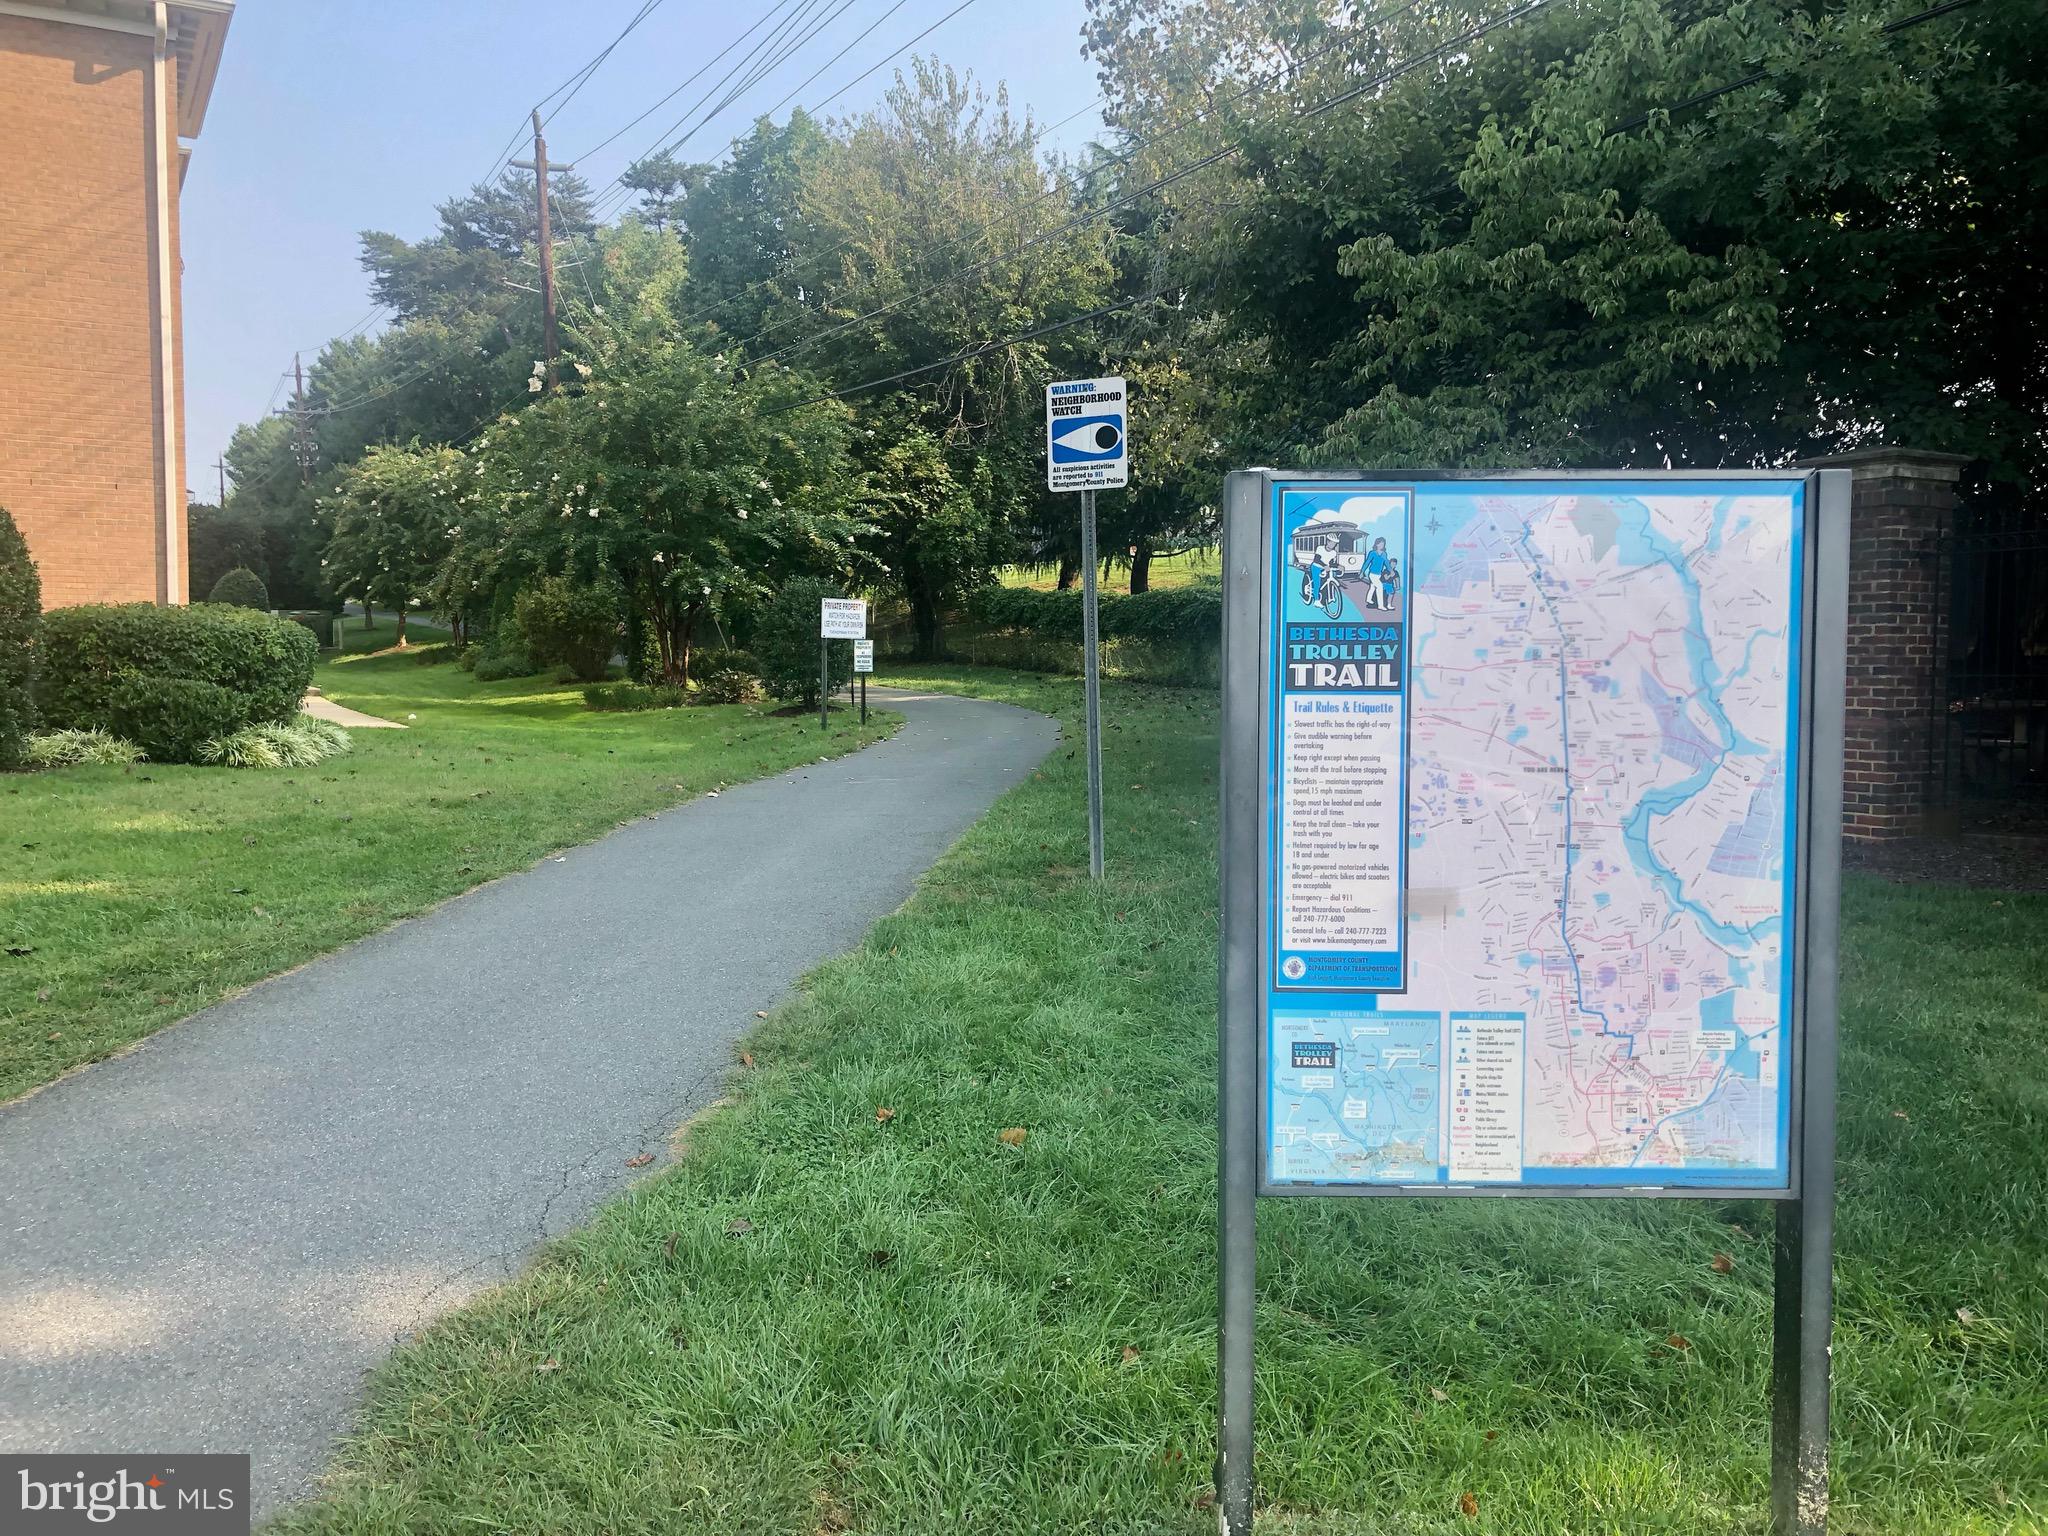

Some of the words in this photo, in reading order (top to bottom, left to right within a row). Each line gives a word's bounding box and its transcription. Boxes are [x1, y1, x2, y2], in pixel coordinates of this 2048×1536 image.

[1051, 383, 1096, 395] WARNING:
[1052, 392, 1122, 407] NEIGHBORHOOD
[1052, 406, 1082, 416] WATCH
[1062, 465, 1089, 473] suspicious
[1053, 480, 1086, 488] Montgomery
[1290, 628, 1398, 641] BETHESDA
[1290, 644, 1399, 660] TROLLEY
[1289, 664, 1399, 688] TRAIL
[1294, 701, 1313, 713] Trail
[1316, 701, 1340, 713] Rules
[1342, 701, 1350, 713] &
[1353, 701, 1394, 715] Etiquette
[1294, 720, 1315, 728] Slowest
[1316, 720, 1333, 728] traffic
[1335, 720, 1344, 728] has
[1346, 720, 1355, 728] the
[1330, 733, 1352, 741] warning
[1294, 742, 1324, 750] overtaking
[1294, 754, 1308, 762] Keep
[1309, 754, 1322, 762] right
[1324, 754, 1342, 762] except
[1360, 755, 1381, 763] passing
[1363, 767, 1387, 775] stopping
[1314, 842, 1338, 850] required
[1339, 842, 1346, 850] by
[1292, 872, 1313, 880] allowed
[1320, 872, 1338, 880] electric
[1340, 872, 1355, 880] bikes
[1356, 872, 1366, 880] and
[1368, 872, 1390, 880] scooters
[1303, 882, 1332, 890] acceptable
[1292, 894, 1322, 902] Emergency
[1295, 1058, 1332, 1066] TRAIL
